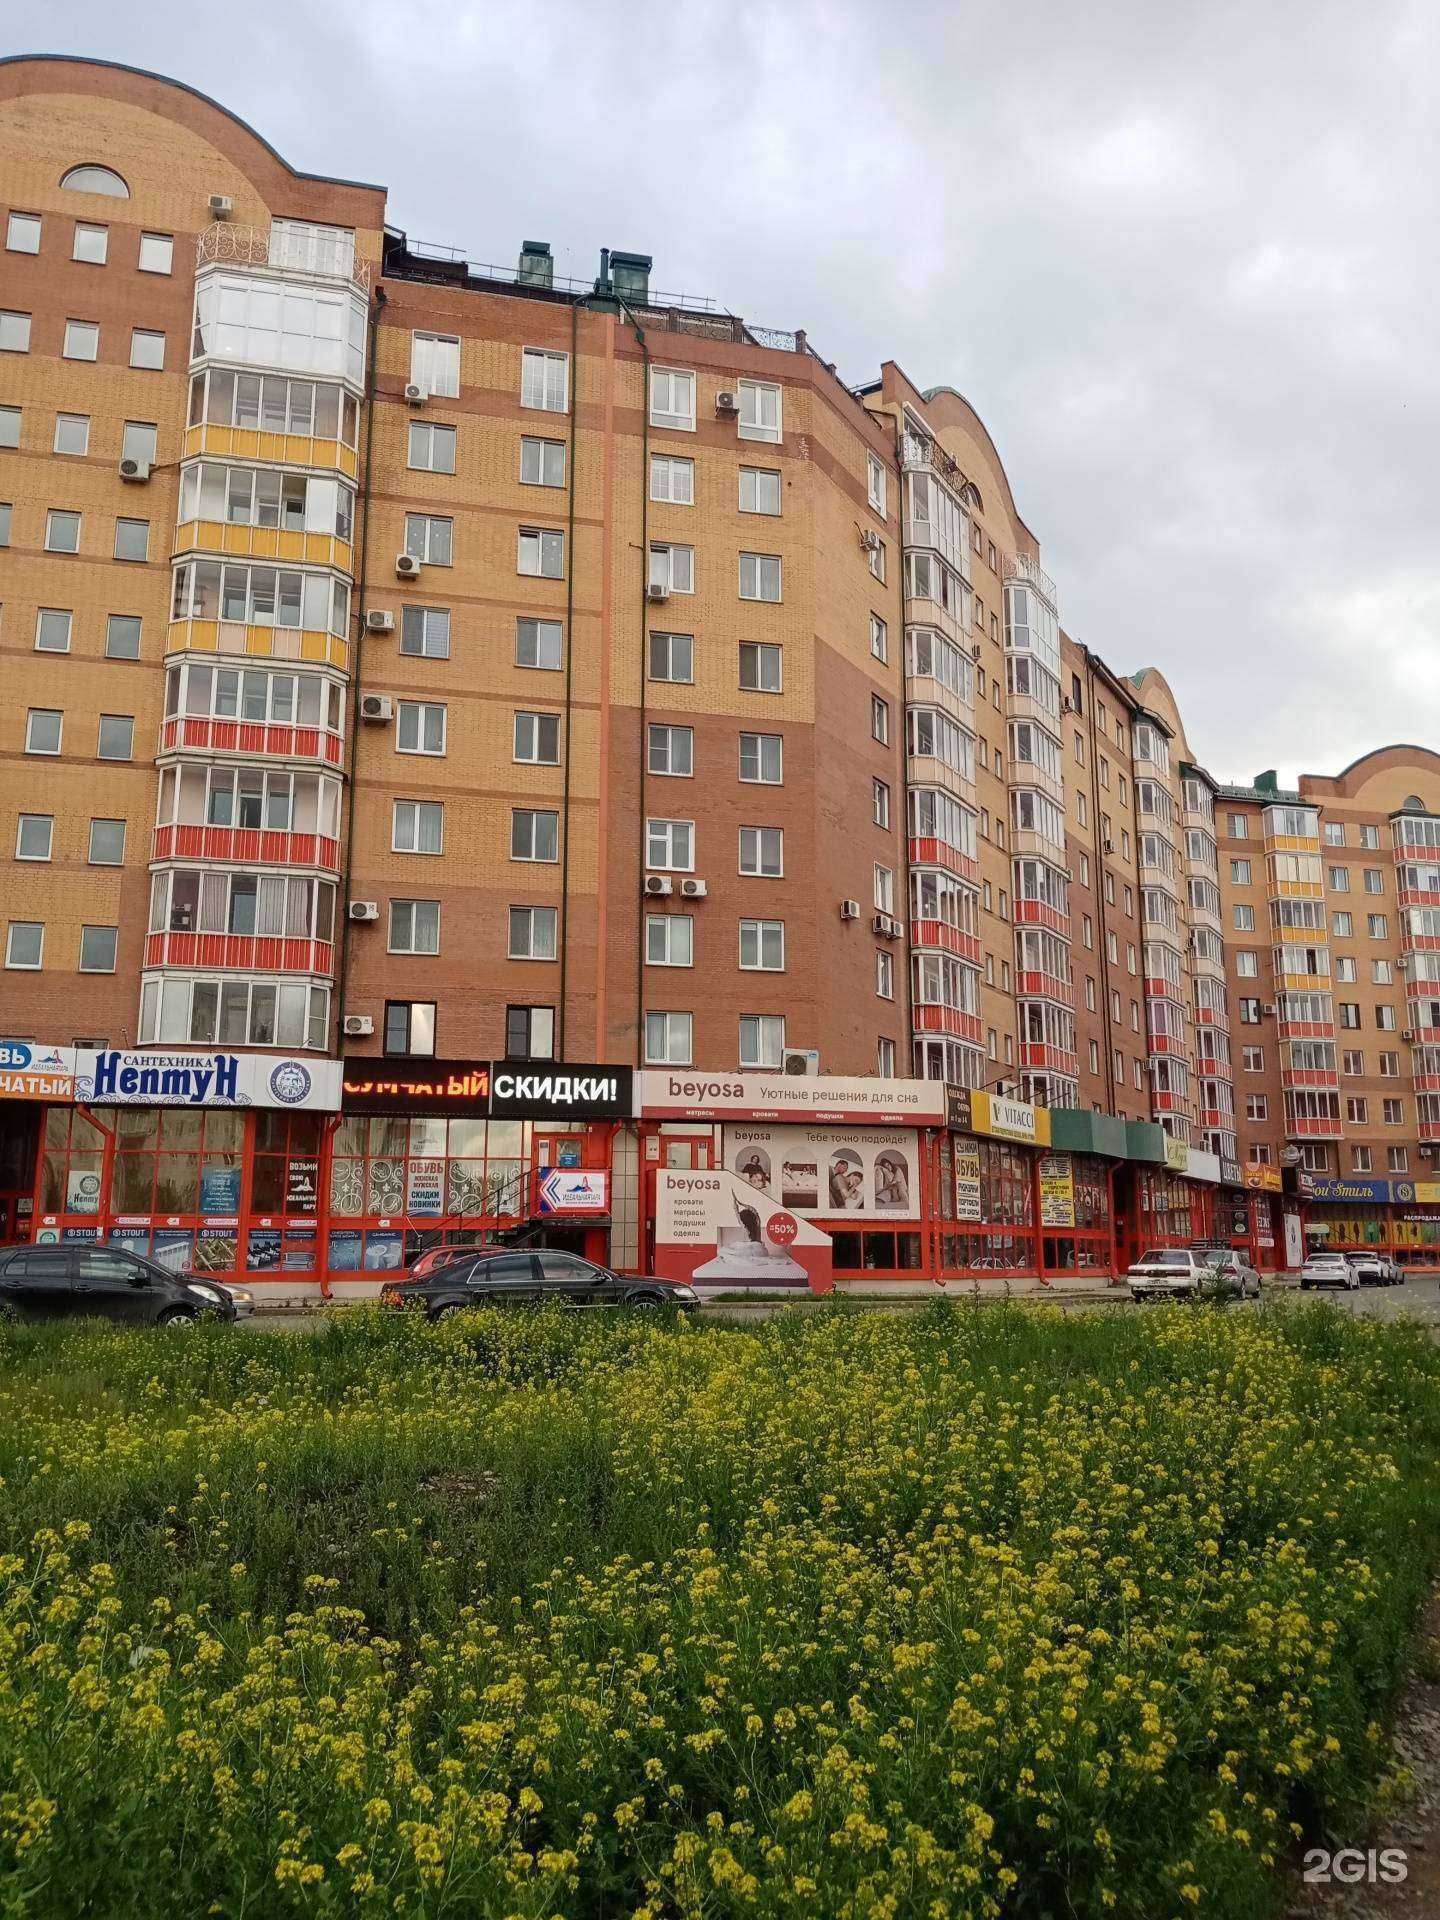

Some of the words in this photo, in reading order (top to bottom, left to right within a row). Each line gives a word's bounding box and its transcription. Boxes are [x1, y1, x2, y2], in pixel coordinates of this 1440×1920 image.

[123, 1055, 213, 1068] САНТЕХНИКА
[494, 1075, 618, 1104] СКИДКИ!
[669, 1077, 744, 1102] beyosa
[759, 1086, 808, 1100] Уютные
[812, 1090, 868, 1102] решения
[871, 1094, 893, 1104] для
[896, 1095, 919, 1104] сна
[1004, 1106, 1034, 1128] VITACCI
[734, 1130, 772, 1144] beyosa
[805, 1132, 828, 1143] Тебе
[830, 1135, 859, 1144] точно
[956, 1140, 978, 1153] СУМКИ
[409, 1162, 444, 1174] ОБУВЬ
[956, 1158, 979, 1178] ОБУВЬ
[666, 1175, 721, 1193] beyosa
[411, 1190, 440, 1200] СКИДКИ
[408, 1200, 441, 1208] НОВИНКИ
[673, 1209, 706, 1217] матрасы
[673, 1220, 707, 1228] подушки
[120, 1229, 146, 1237] STOUT
[210, 1230, 234, 1238] STOUT
[673, 1230, 701, 1238] одеяла
